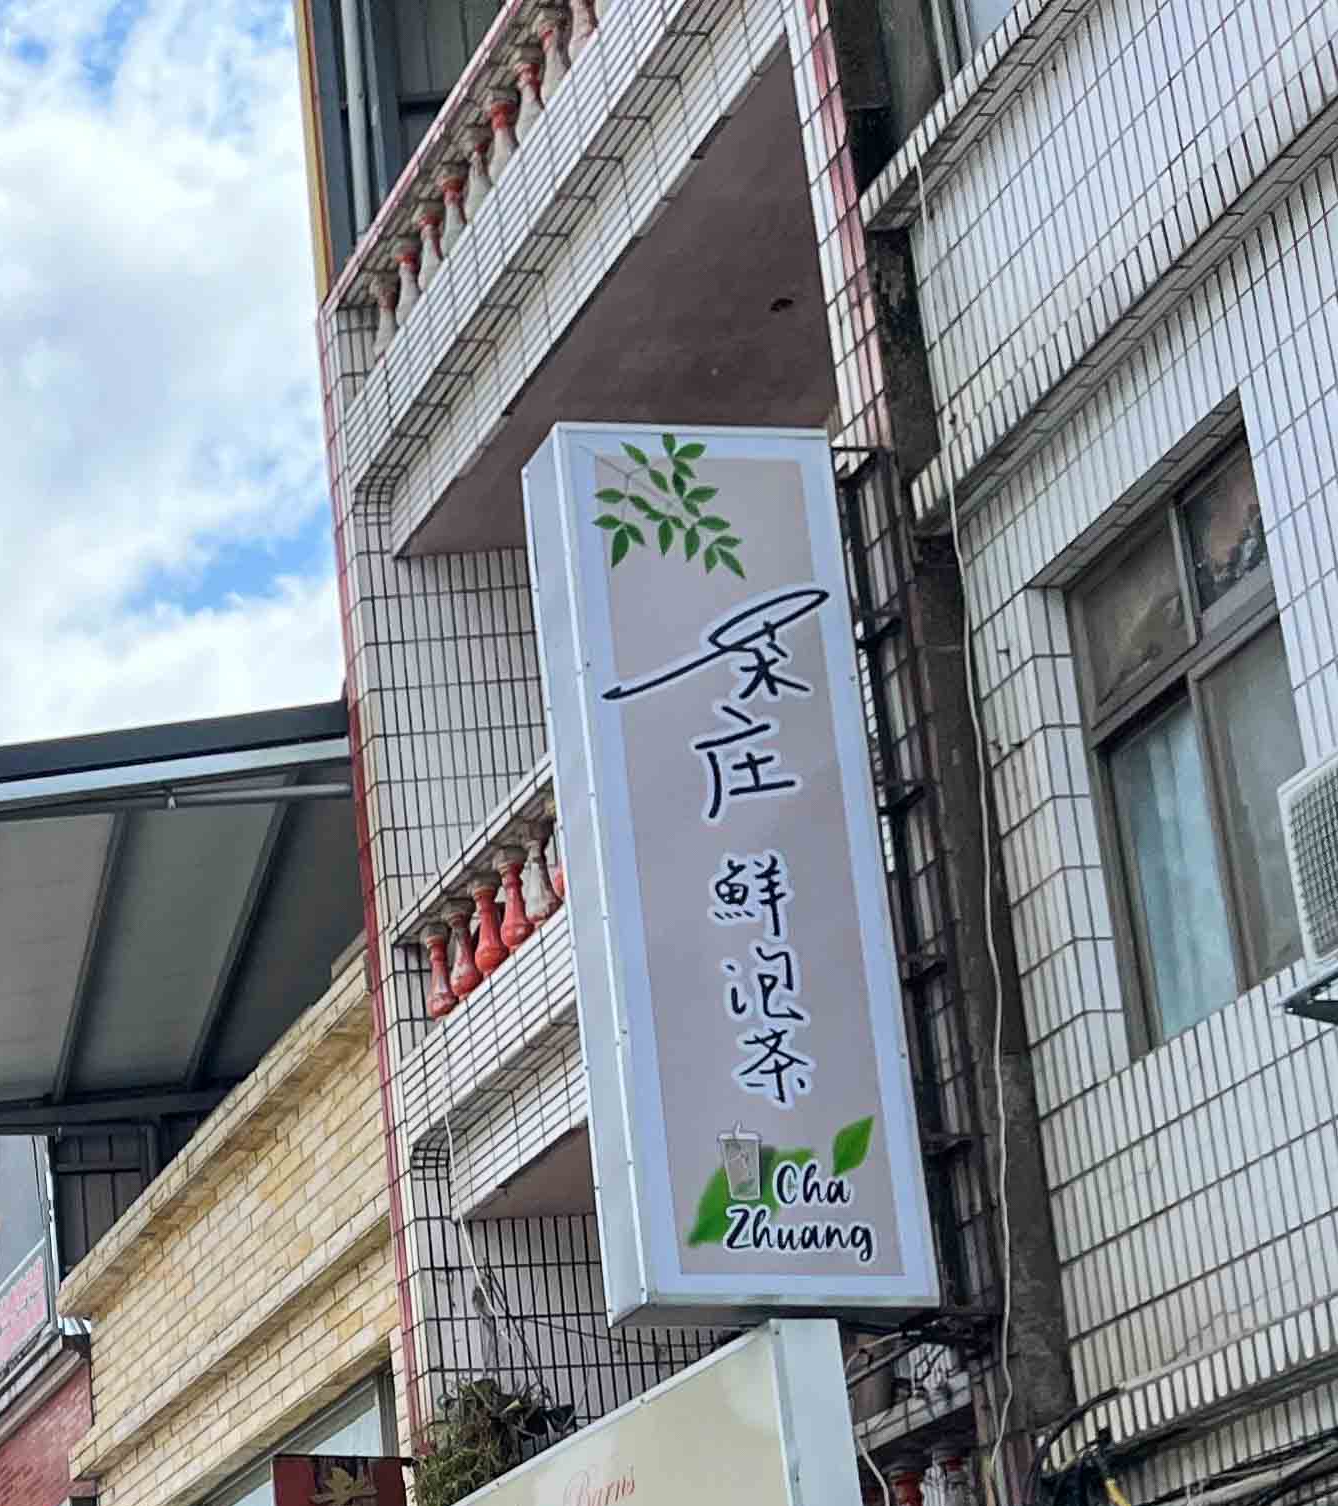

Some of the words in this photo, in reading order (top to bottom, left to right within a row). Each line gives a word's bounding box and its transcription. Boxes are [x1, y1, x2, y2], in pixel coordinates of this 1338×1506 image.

[714, 853, 809, 1103] 鮮泡茶
[776, 1164, 851, 1204] Cha
[726, 1208, 873, 1263] Zhuang
